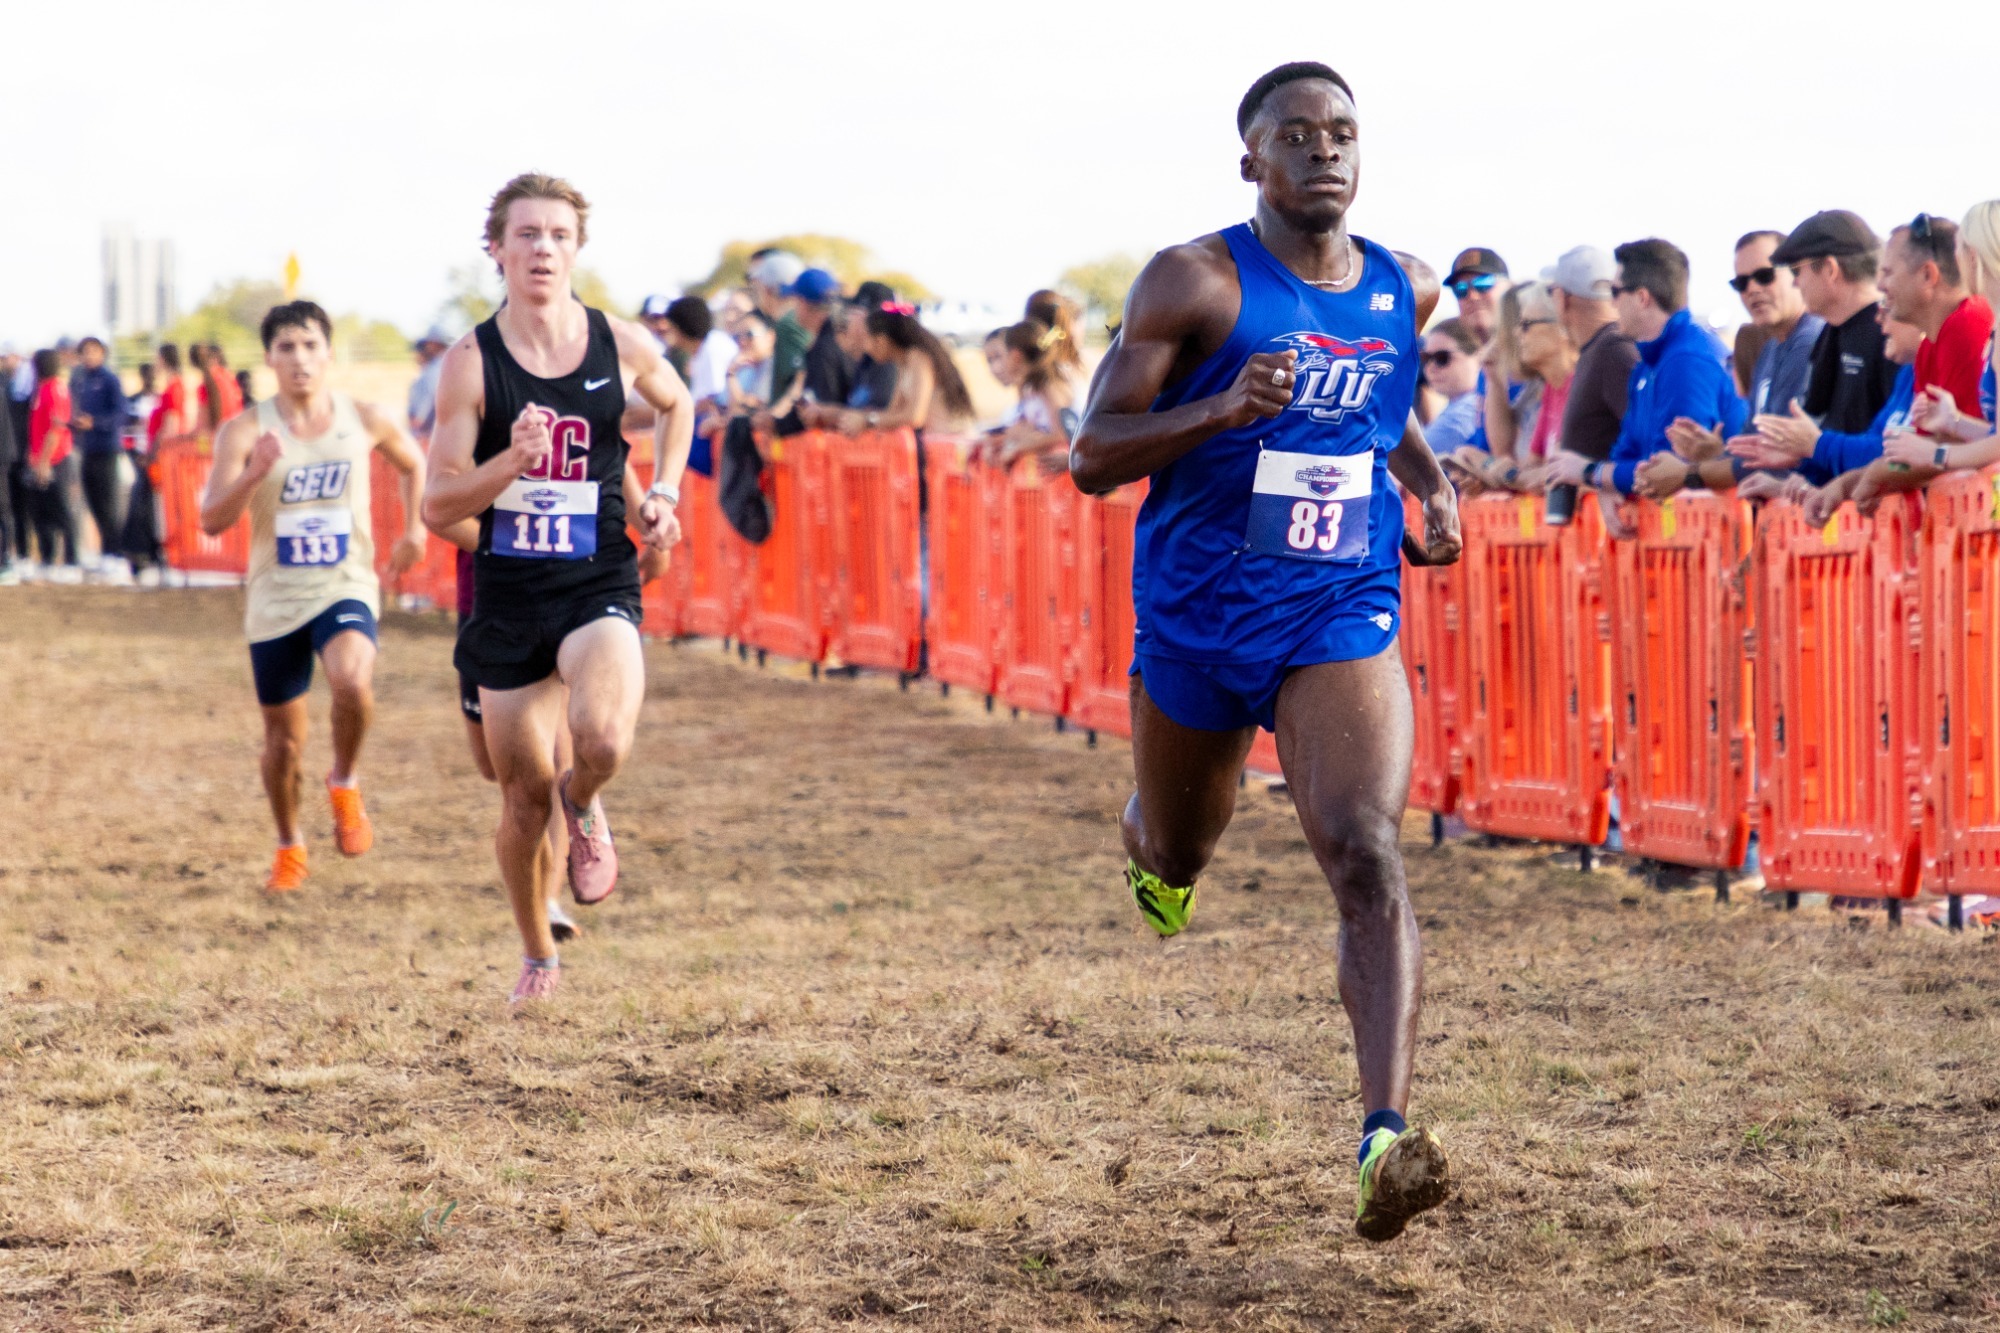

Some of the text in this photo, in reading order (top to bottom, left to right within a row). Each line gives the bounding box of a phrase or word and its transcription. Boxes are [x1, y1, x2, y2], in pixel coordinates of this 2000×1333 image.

[1296, 358, 1378, 421] LCU
[280, 462, 351, 503] SEU
[512, 513, 574, 552] 111
[1287, 500, 1344, 551] 83
[291, 535, 339, 563] 133
